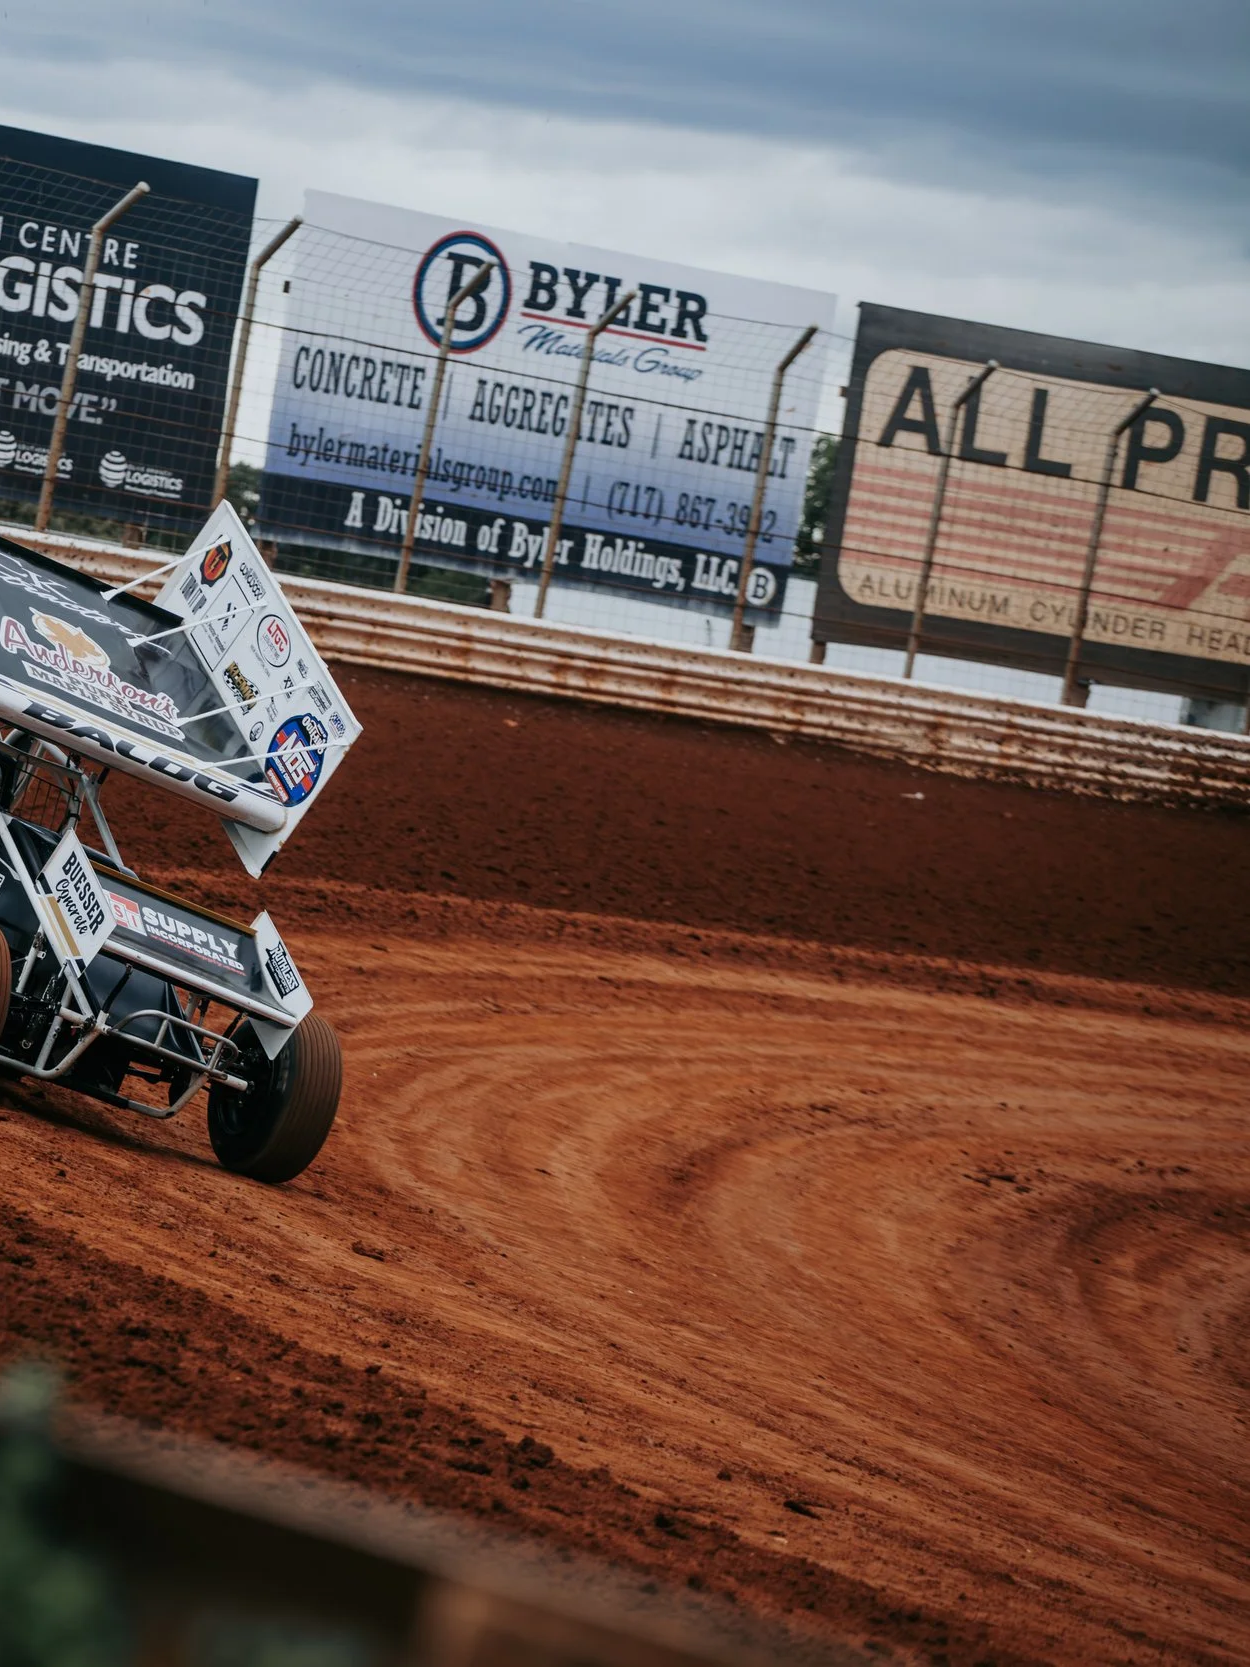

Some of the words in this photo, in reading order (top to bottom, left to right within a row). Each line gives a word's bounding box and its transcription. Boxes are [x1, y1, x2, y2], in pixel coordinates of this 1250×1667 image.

[18, 222, 140, 270] CENRE
[523, 261, 709, 343] BYLER
[34, 339, 52, 365] &
[56, 342, 196, 391] Tansportation
[293, 346, 426, 410] CONCRETE
[633, 347, 704, 384] Group
[877, 366, 1077, 478] ALL
[125, 471, 183, 491] LOGISTICS
[608, 480, 664, 526] (717)
[676, 493, 778, 543] 867-392
[344, 491, 366, 529] A
[477, 518, 506, 554] of
[580, 533, 687, 592] Holdings,
[1029, 600, 1166, 642] CYLNDER
[0, 615, 180, 721] Anderson's
[66, 671, 129, 708] PURE
[30, 664, 103, 705] MAPLE
[110, 699, 181, 739] SYRUP
[23, 701, 240, 803] BALOG
[277, 731, 319, 786] NOS
[55, 878, 88, 935] Concrete
[62, 850, 105, 936] BUESSER
[141, 906, 239, 960] SUPPLY
[146, 923, 245, 972] INCORPORATED
[269, 943, 299, 991] RUTHLESS
